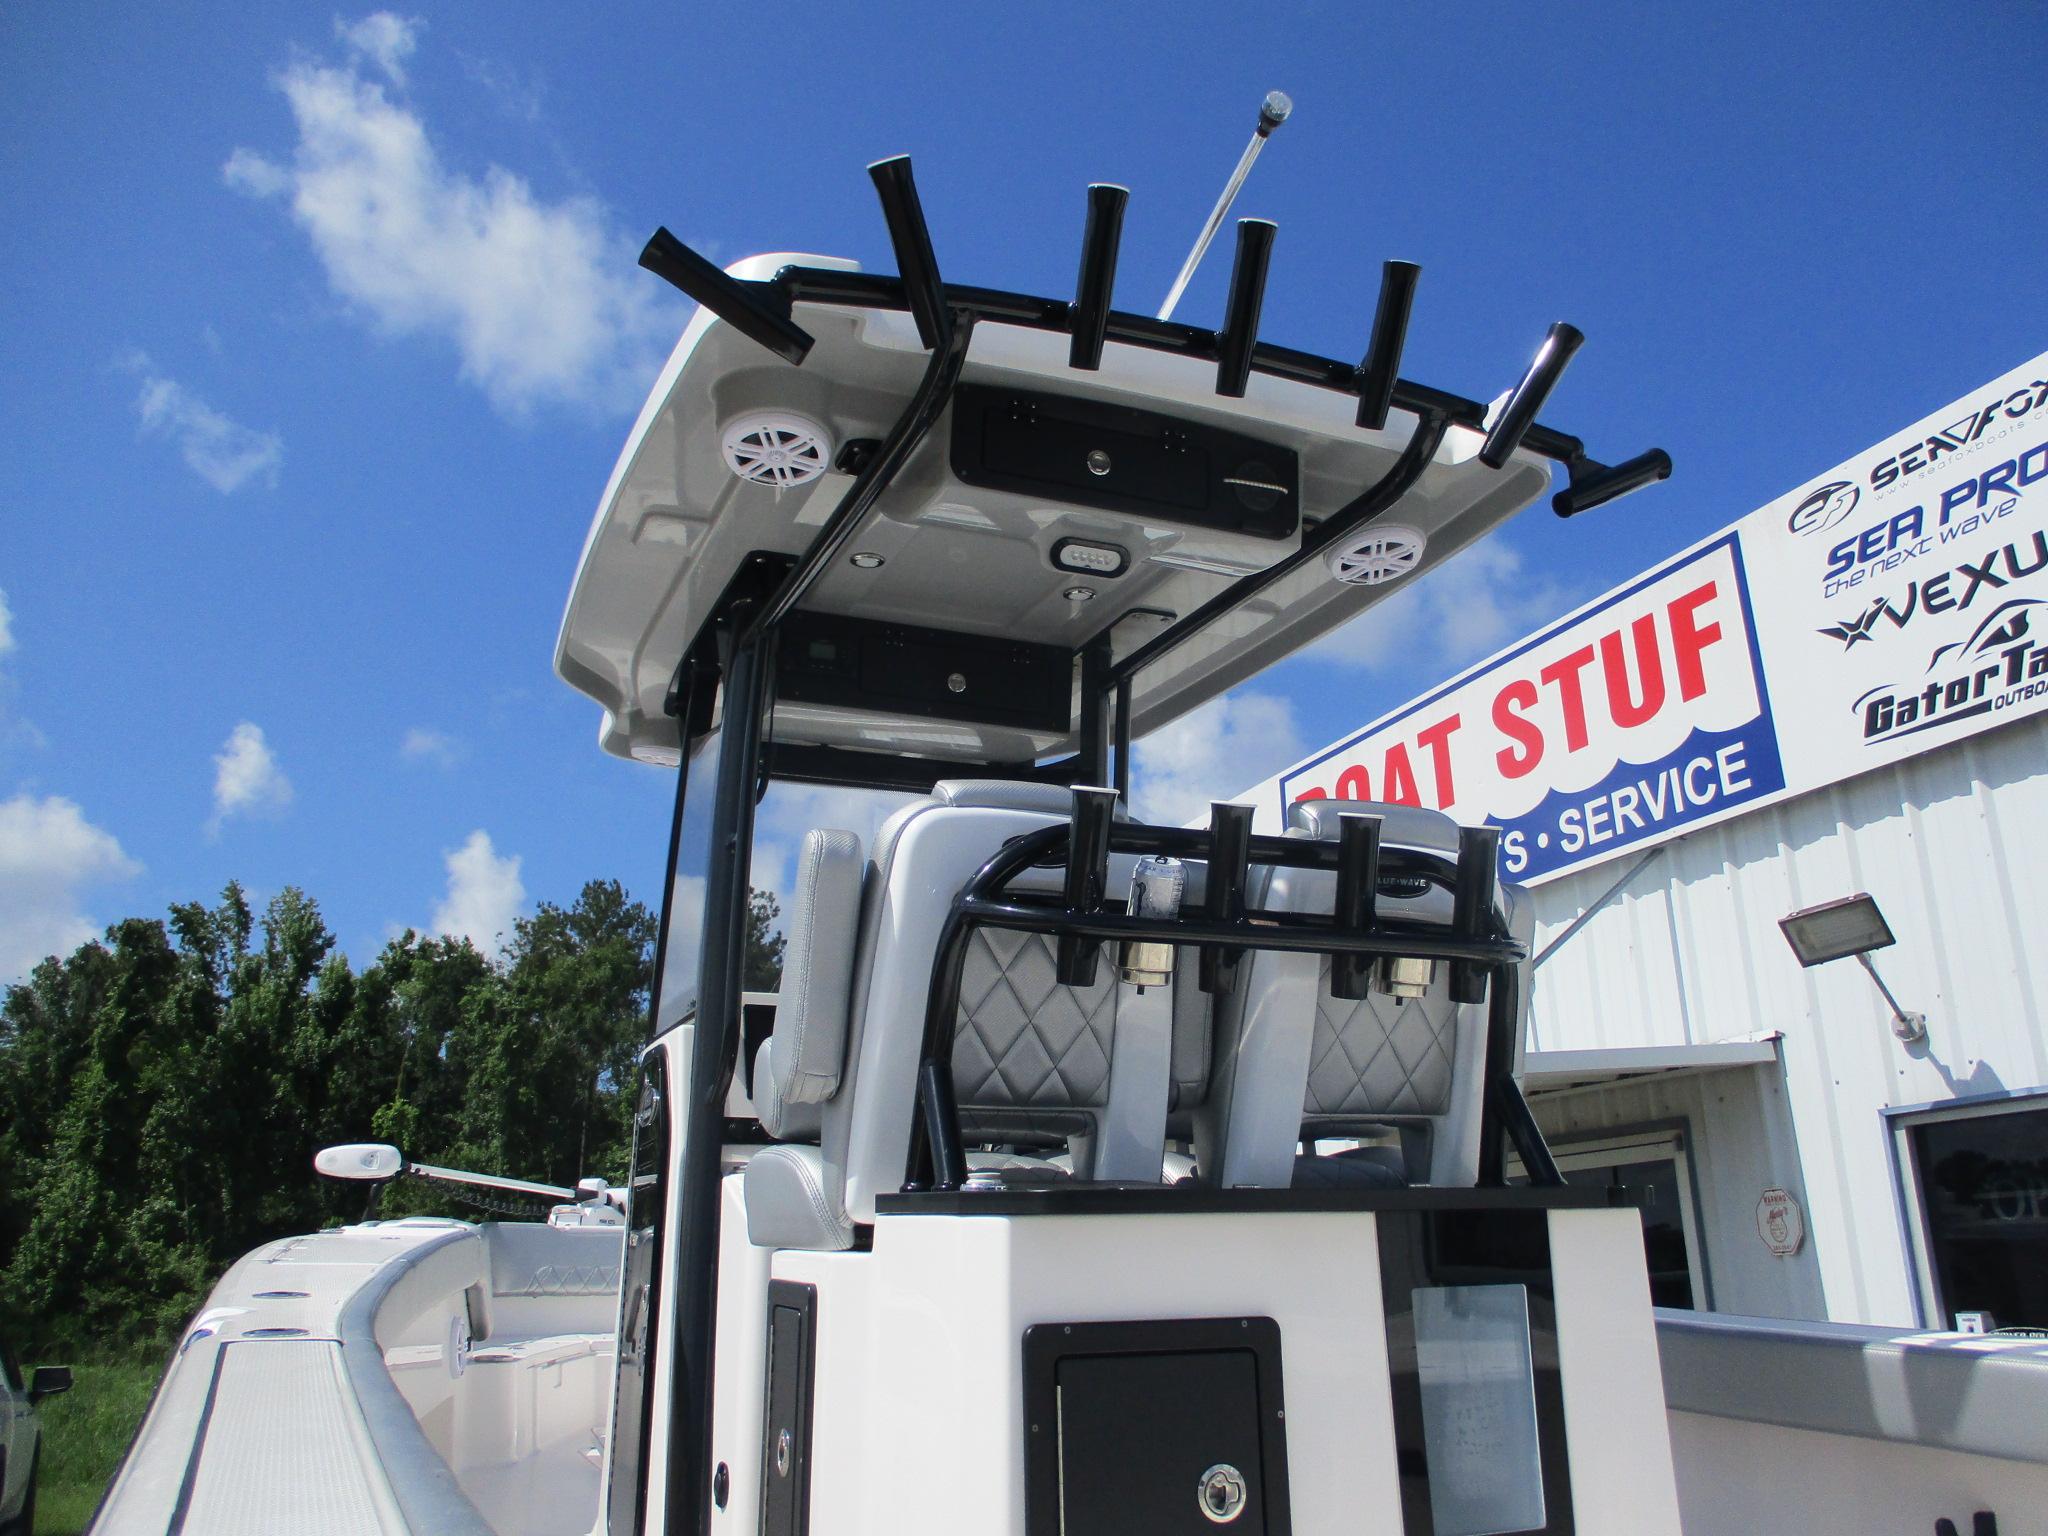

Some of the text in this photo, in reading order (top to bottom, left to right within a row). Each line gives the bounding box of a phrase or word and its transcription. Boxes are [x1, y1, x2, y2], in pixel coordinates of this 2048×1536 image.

[1822, 440, 2048, 582] SEA PRO
[1823, 496, 2017, 599] the next wave
[1295, 580, 1723, 812] AT STUF
[1557, 741, 1753, 853] SERVICE
